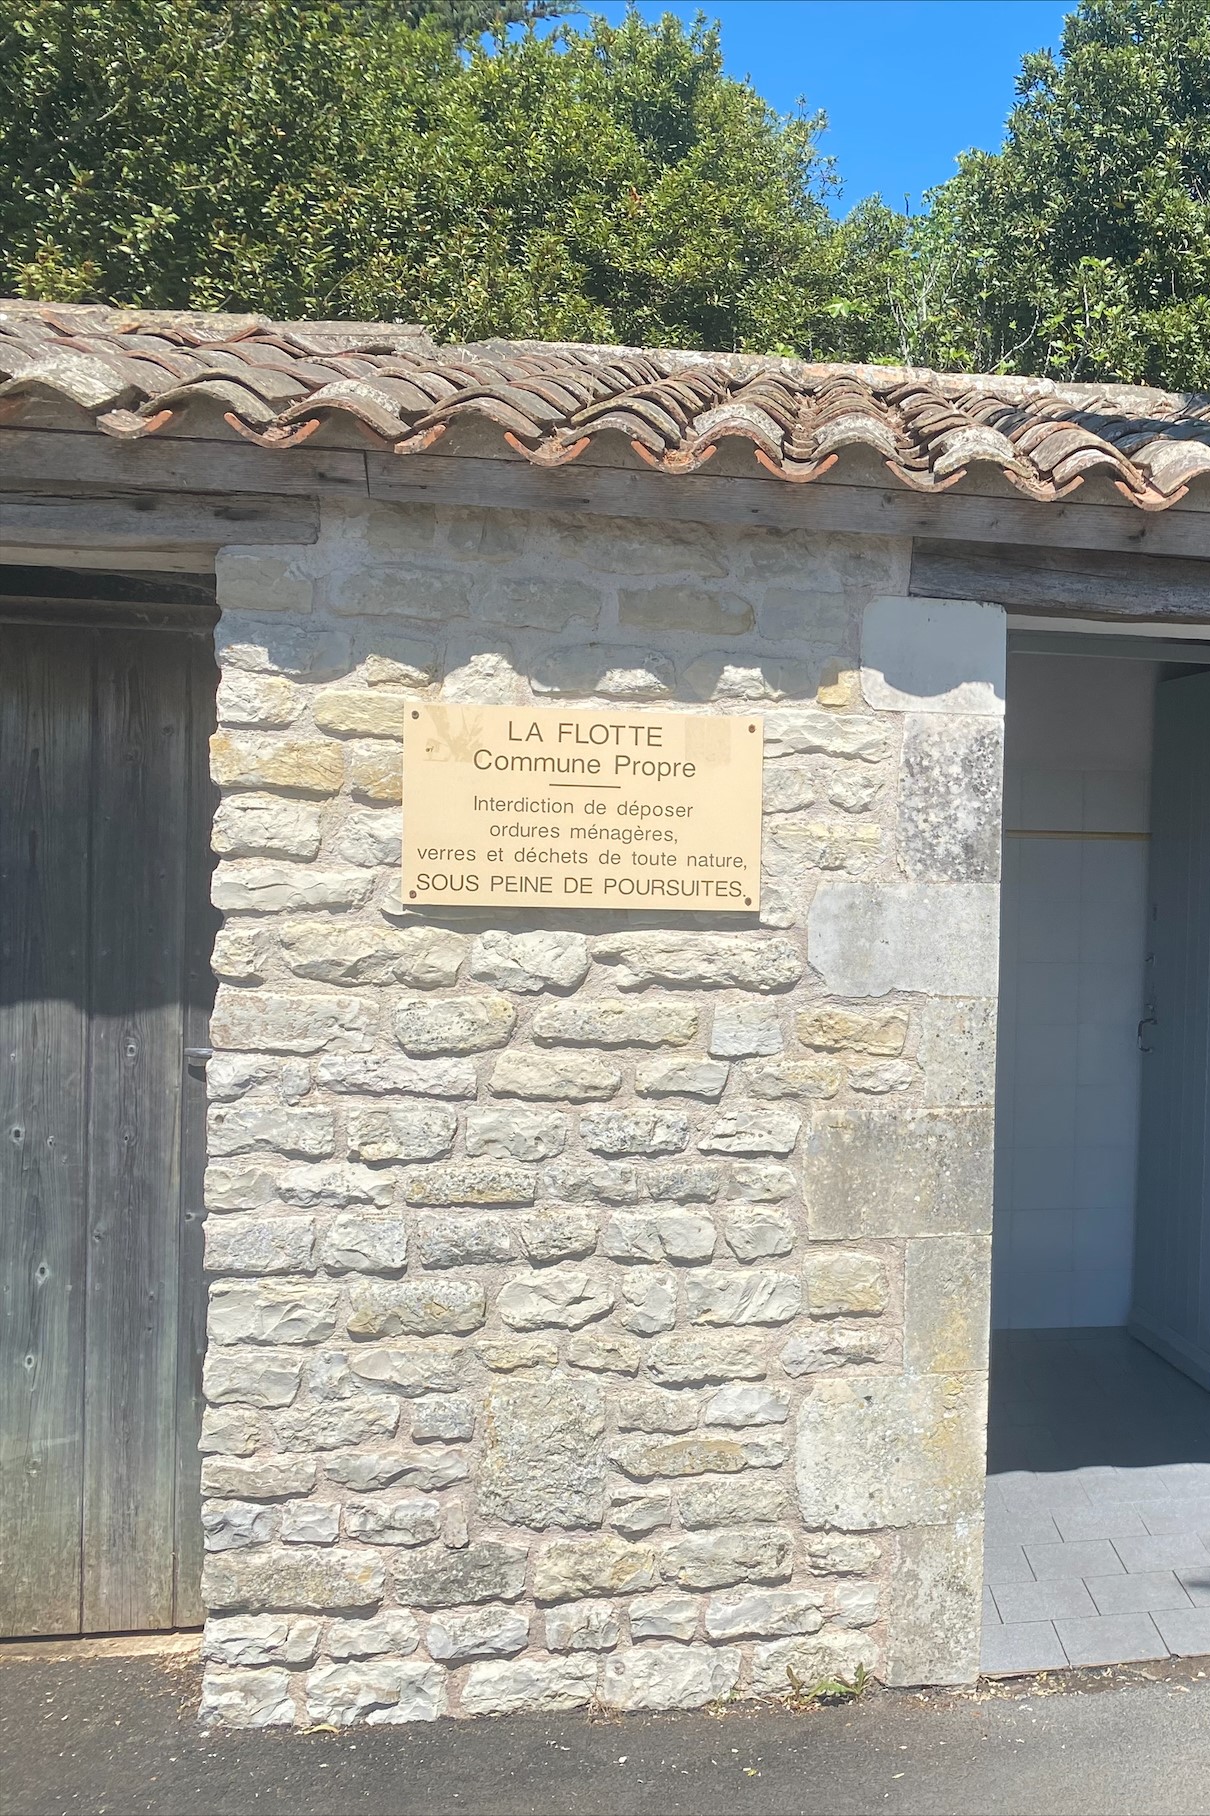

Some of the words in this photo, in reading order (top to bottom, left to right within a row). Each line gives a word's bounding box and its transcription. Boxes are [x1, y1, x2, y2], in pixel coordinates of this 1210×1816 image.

[508, 721, 544, 743] LA
[558, 722, 663, 747] FLOTTE
[473, 749, 601, 774] Commune
[615, 755, 696, 781] Propre
[473, 796, 574, 814] Interdiction
[584, 799, 607, 816] de
[617, 800, 693, 820] déposer
[489, 822, 560, 839] ordures
[570, 825, 678, 844] ménagères,
[417, 846, 476, 861] verres
[486, 846, 504, 863] et
[514, 846, 588, 865] déchets
[599, 850, 621, 865] de
[631, 851, 677, 867] toute
[687, 853, 748, 871] nature,
[416, 873, 479, 892] SOUS
[490, 875, 553, 894] PEINE
[564, 877, 593, 894] DE
[603, 878, 747, 898] POURSUITES.
